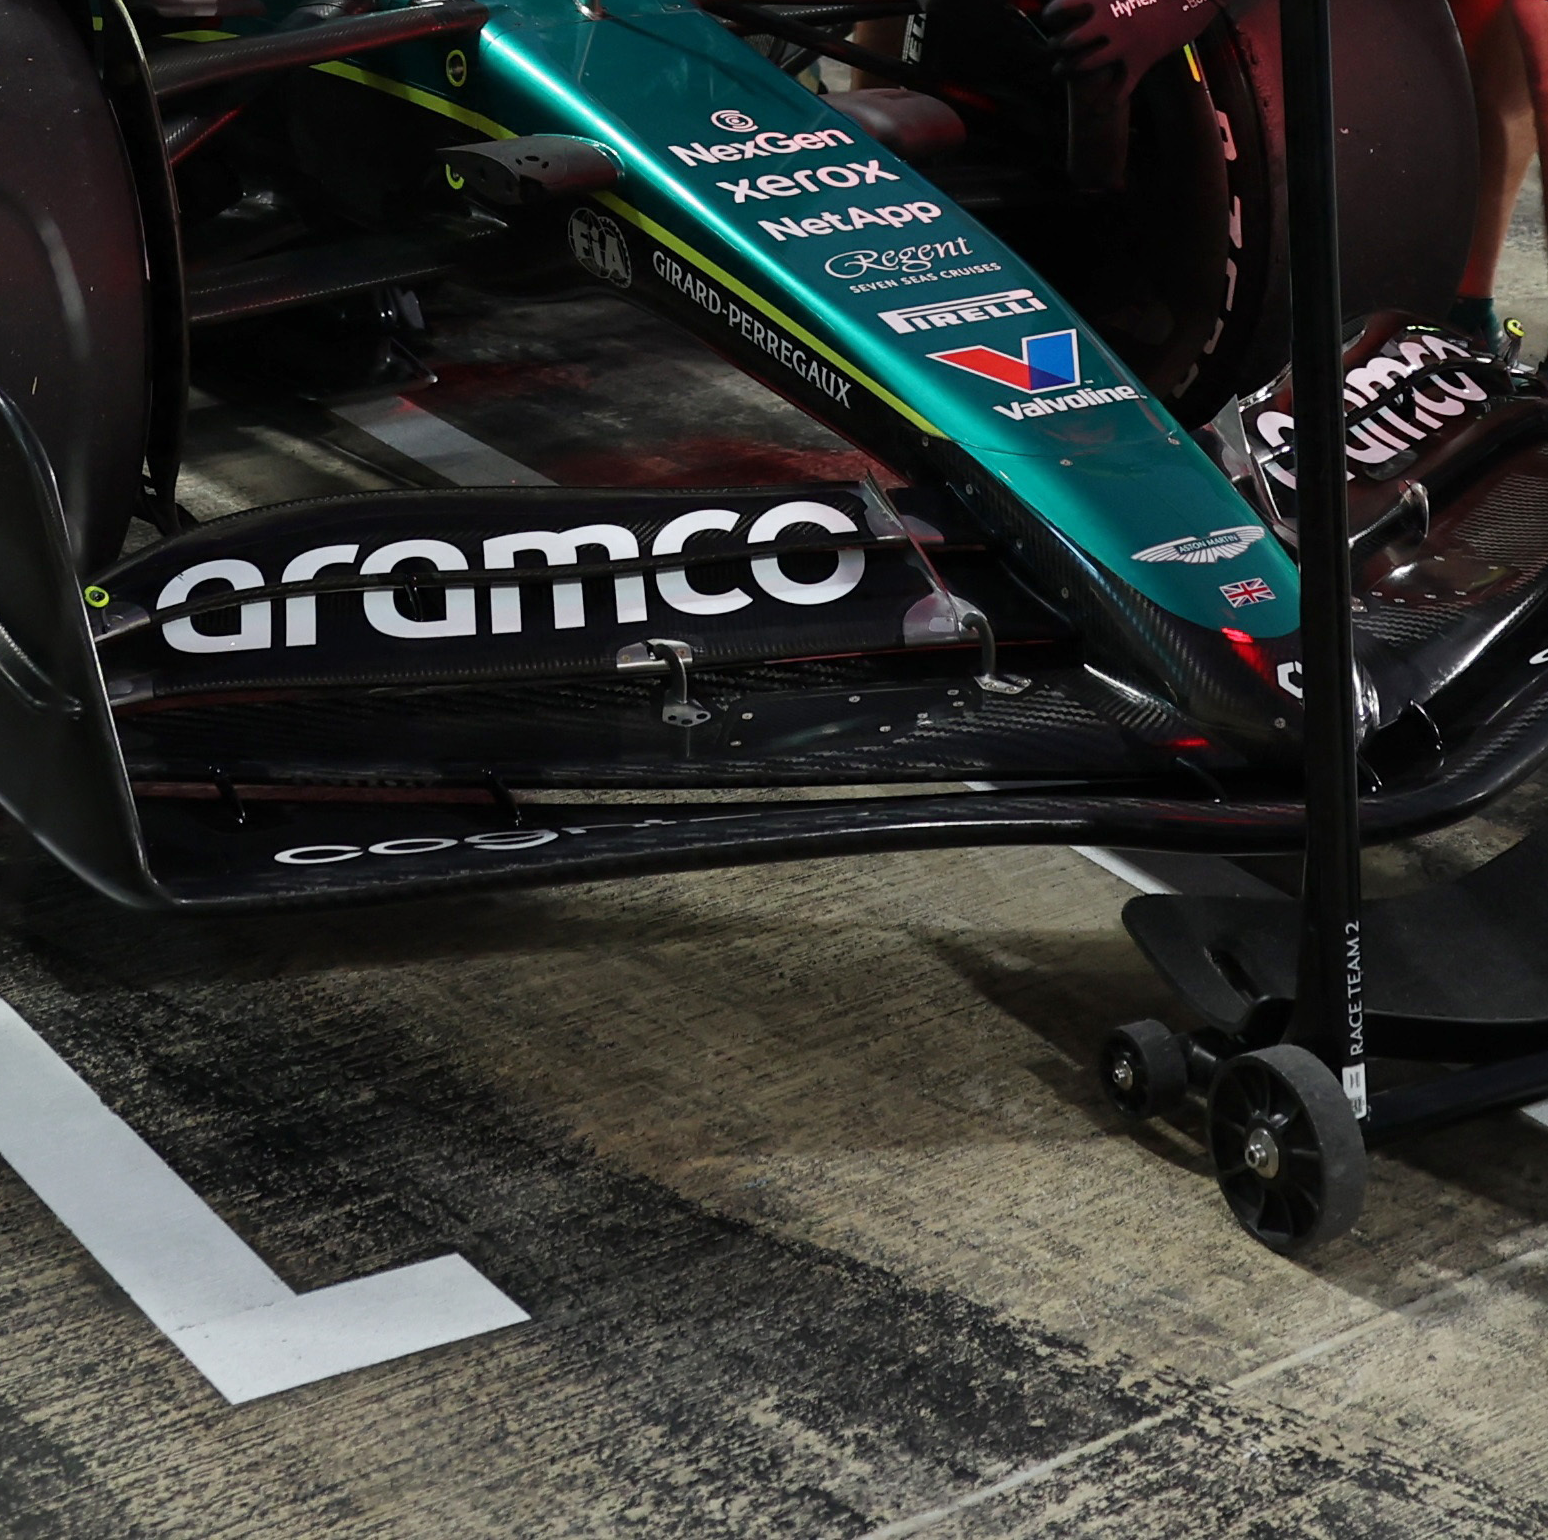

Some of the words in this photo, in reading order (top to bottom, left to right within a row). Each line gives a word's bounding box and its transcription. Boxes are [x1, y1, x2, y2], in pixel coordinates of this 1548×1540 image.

[667, 125, 855, 167] NexGen
[715, 158, 901, 205] xerox
[756, 198, 943, 242] NetApp
[823, 235, 975, 280] Regent
[849, 278, 899, 295] SEVEN
[900, 271, 939, 287] SEAS
[939, 261, 1003, 280] CRUISES
[652, 249, 852, 410] GIRARD-PERREGAUX
[876, 288, 1048, 335] PIRELLI
[991, 382, 1141, 422] Valvoline
[1177, 541, 1205, 555] ASTON
[1206, 533, 1240, 549] MARTIN
[154, 499, 866, 654] aramco
[1345, 919, 1360, 933] 2
[1346, 936, 1363, 1000] TEAM
[1348, 999, 1364, 1057] RACE
